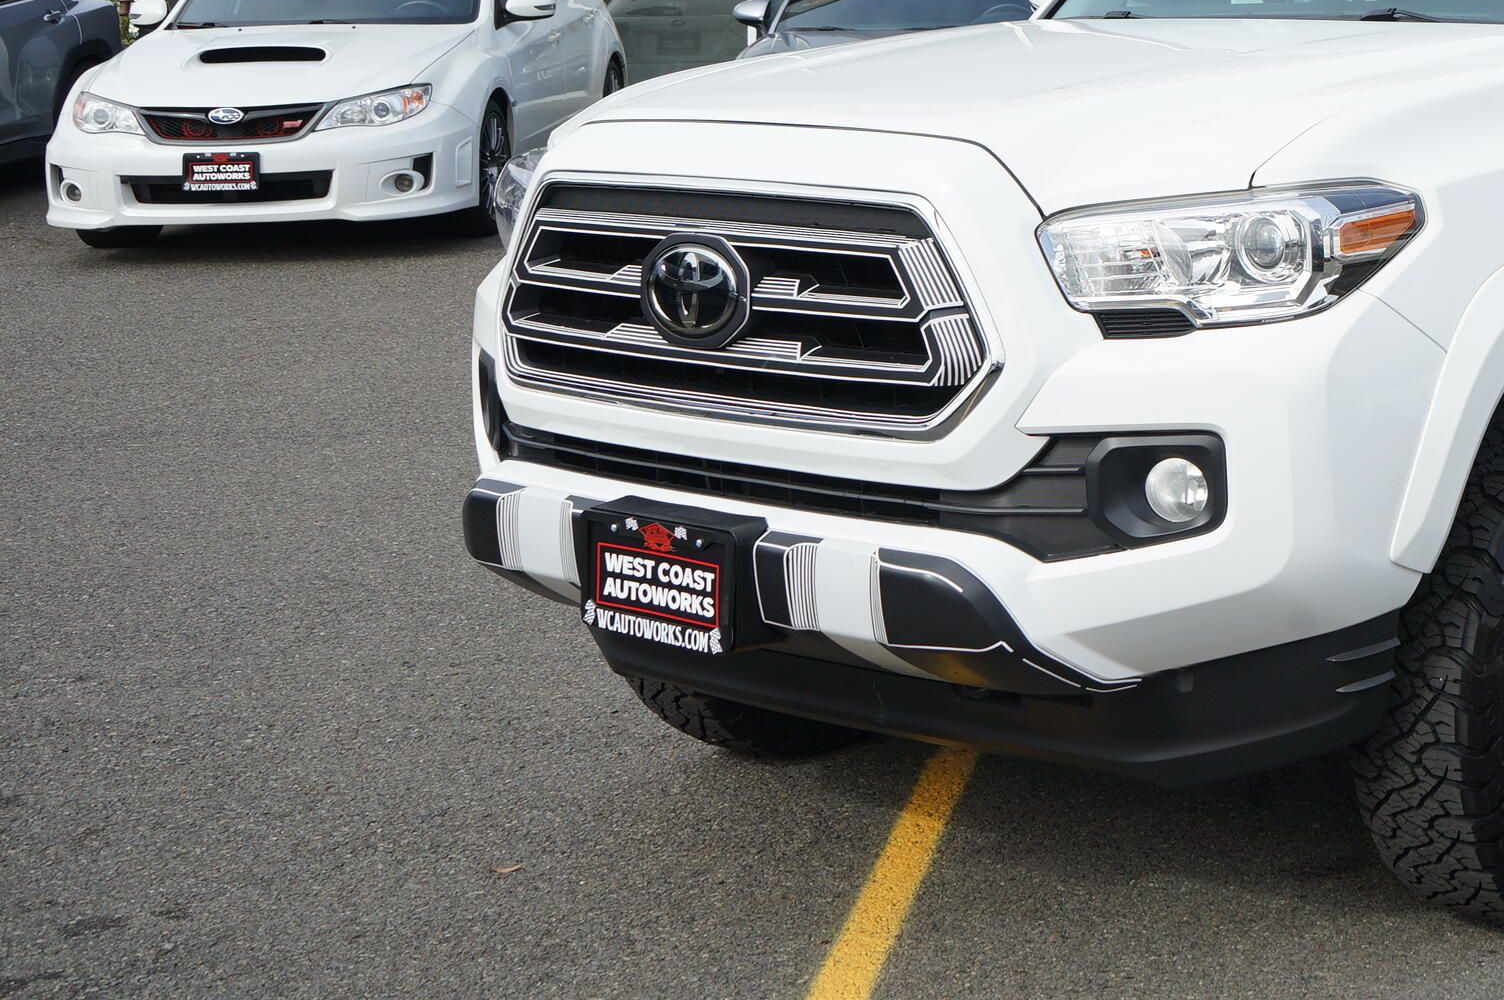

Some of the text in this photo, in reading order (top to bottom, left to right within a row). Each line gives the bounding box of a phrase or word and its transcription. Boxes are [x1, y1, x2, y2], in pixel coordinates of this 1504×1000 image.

[192, 172, 251, 181] AUTOWORKS
[220, 164, 251, 172] COAST
[604, 552, 715, 592] WEST COAST
[603, 577, 715, 618] AUTOWORKS
[596, 608, 709, 653] WCAUTOWORKS.COM
